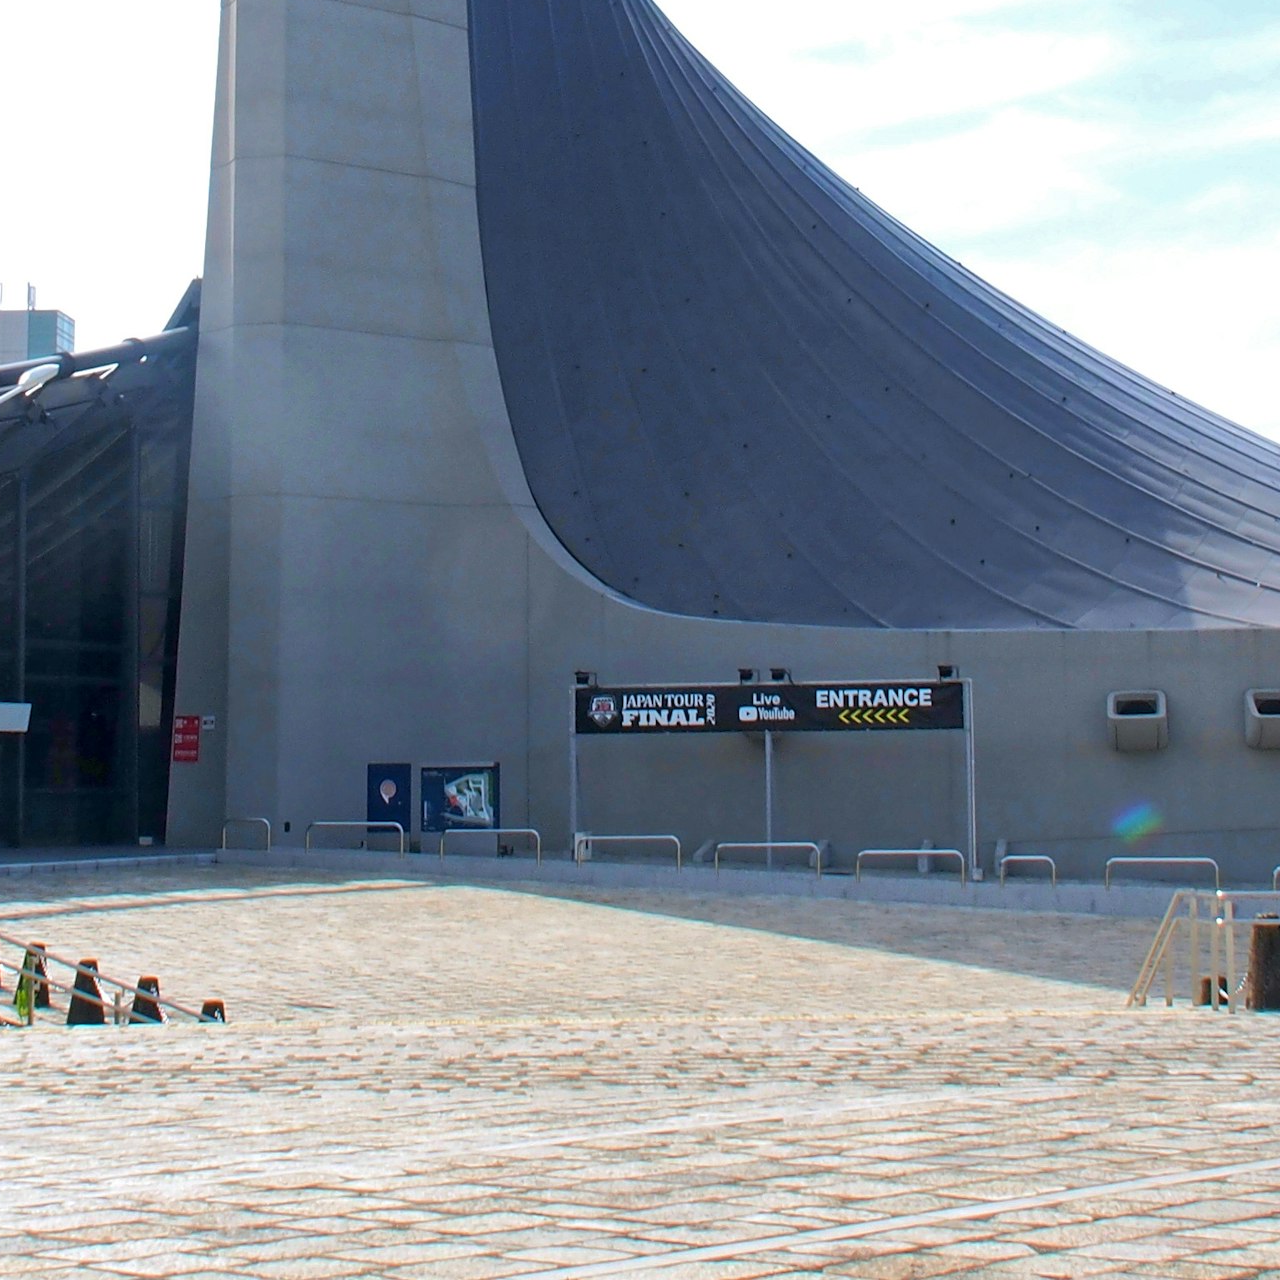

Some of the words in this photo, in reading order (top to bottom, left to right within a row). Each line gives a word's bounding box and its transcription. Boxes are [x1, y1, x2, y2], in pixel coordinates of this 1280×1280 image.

[621, 694, 663, 710] JAPAN
[664, 693, 704, 708] TOUR
[752, 693, 781, 706] Live
[815, 688, 933, 708] ENTRANCE
[621, 708, 705, 727] FINAL
[706, 693, 716, 726] 2020
[757, 707, 795, 721] YouTube
